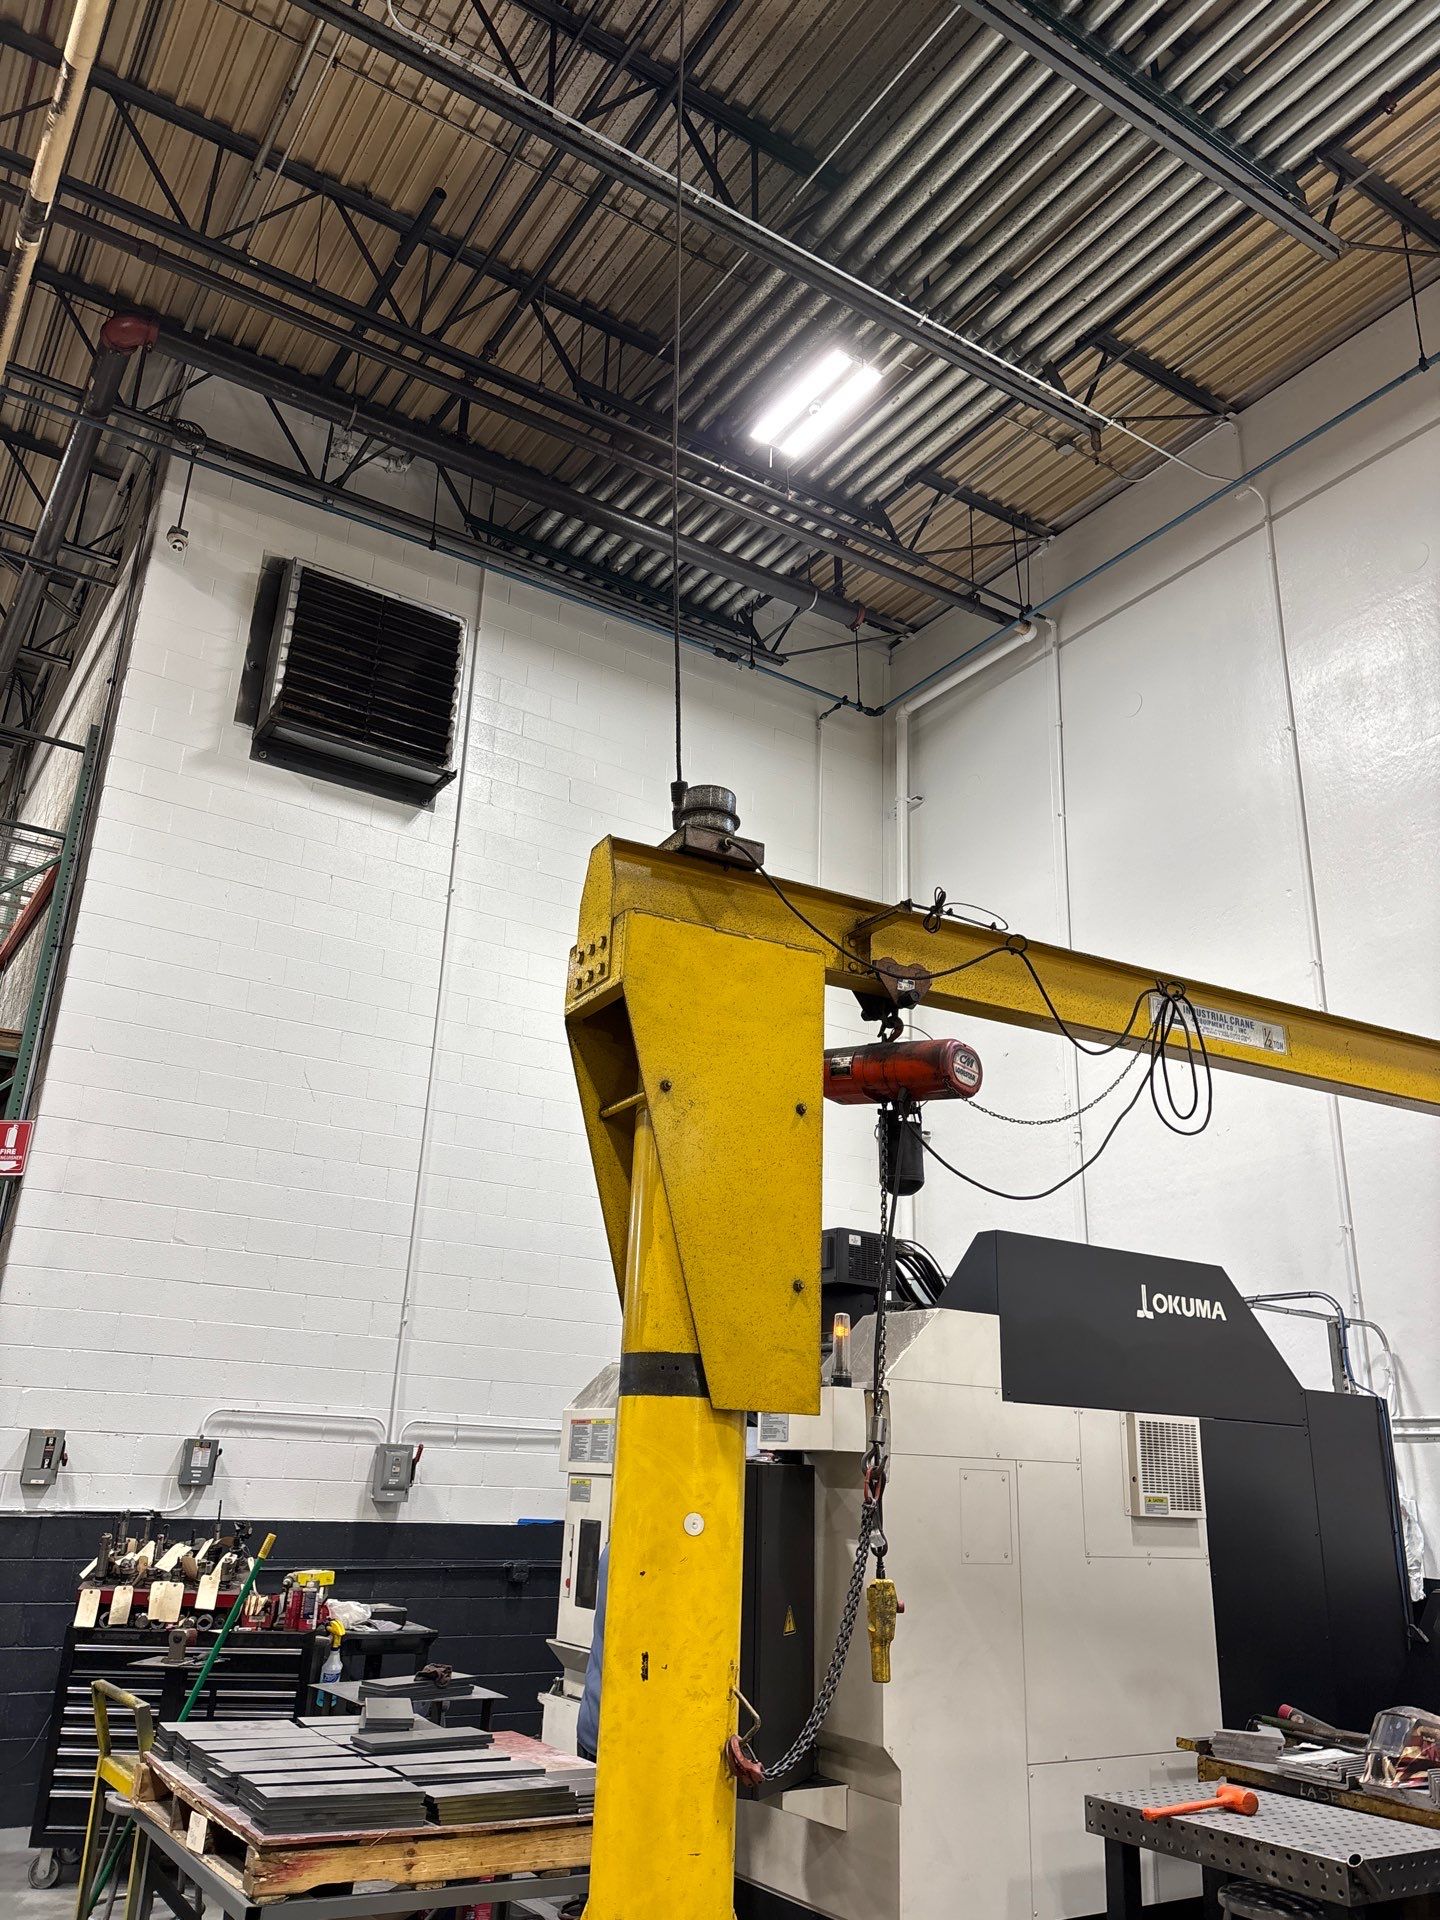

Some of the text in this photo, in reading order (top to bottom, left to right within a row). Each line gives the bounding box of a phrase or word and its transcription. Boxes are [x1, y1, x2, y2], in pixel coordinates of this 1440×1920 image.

[1183, 1005, 1255, 1030] INUSTRIAL CRANE
[1198, 1018, 1226, 1029] QUIPMENT
[1273, 1041, 1284, 1050] TON
[1152, 1292, 1228, 1321] OKUMA
